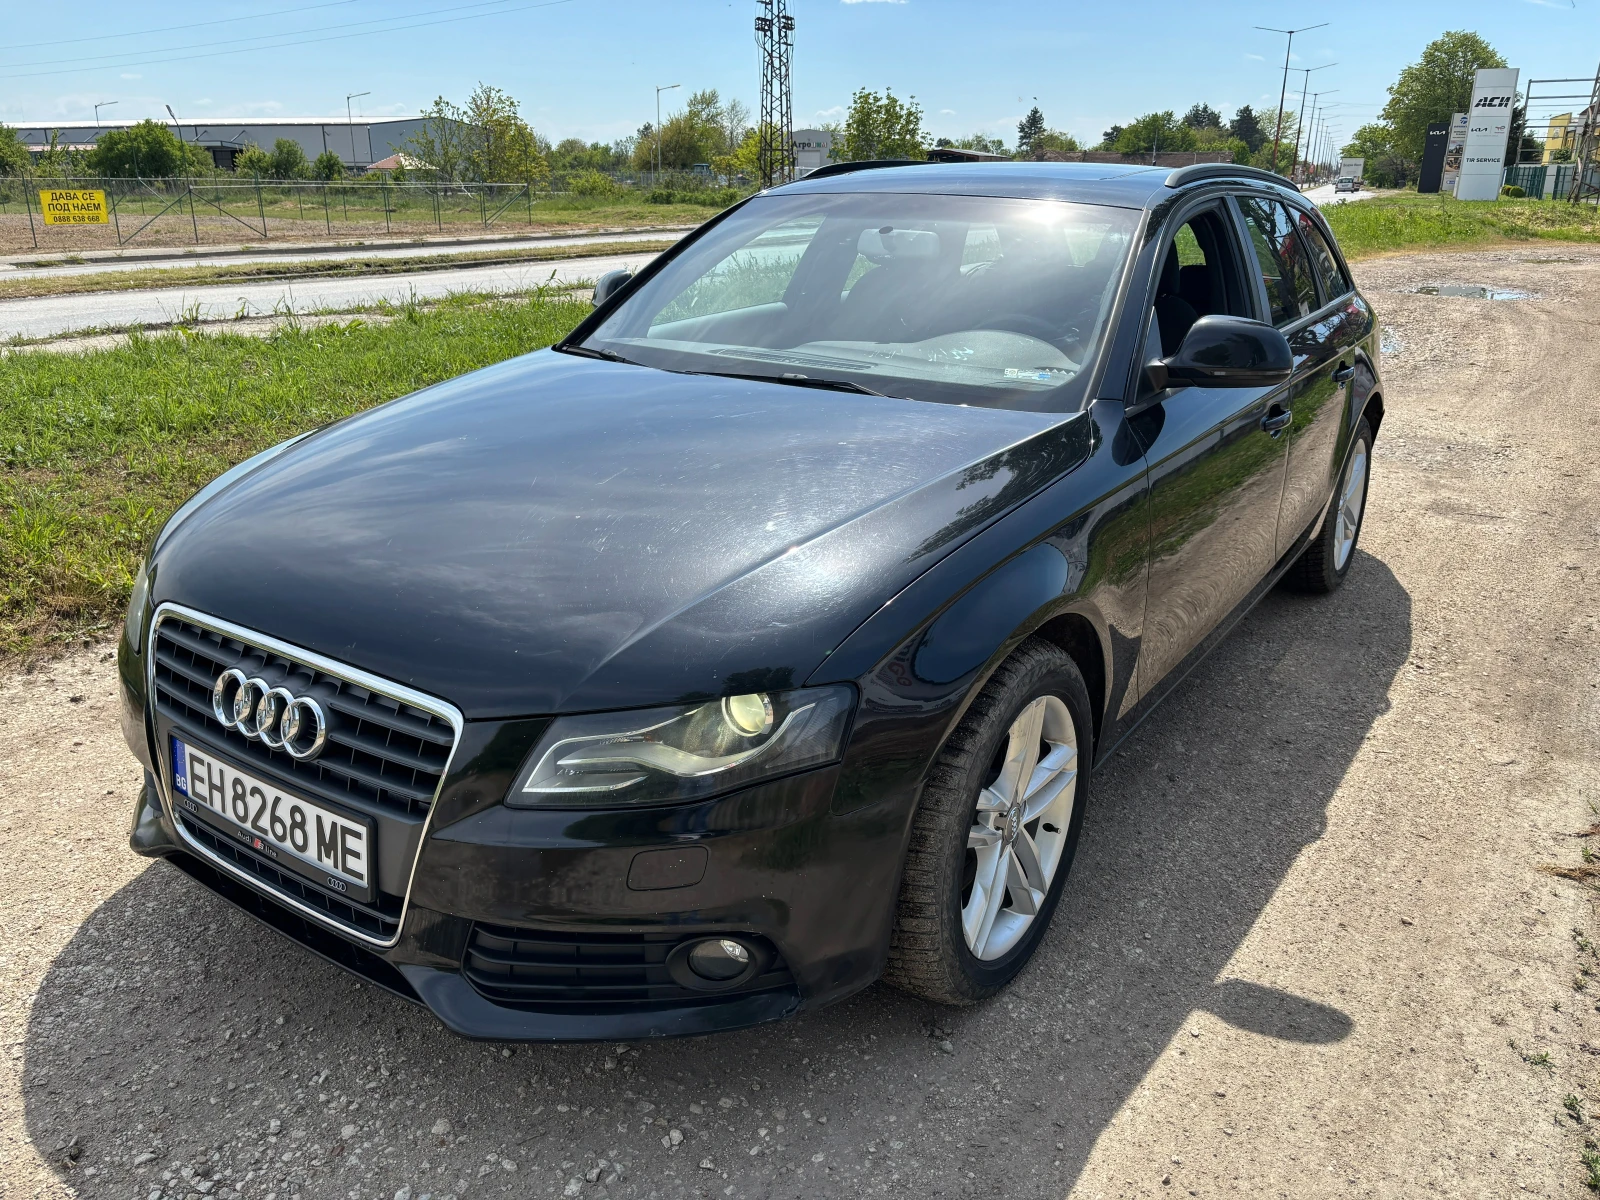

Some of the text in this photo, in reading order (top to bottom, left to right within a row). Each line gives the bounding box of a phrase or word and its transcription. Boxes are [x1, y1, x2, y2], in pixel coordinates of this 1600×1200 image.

[51, 192, 96, 202] ДАВА СЕ
[47, 203, 102, 213] ПОД НАЕМ
[53, 215, 71, 223] 0888
[175, 773, 188, 791] BG
[188, 752, 365, 881] EH 8268 ME
[237, 830, 252, 843] Audi
[265, 845, 278, 858] line
